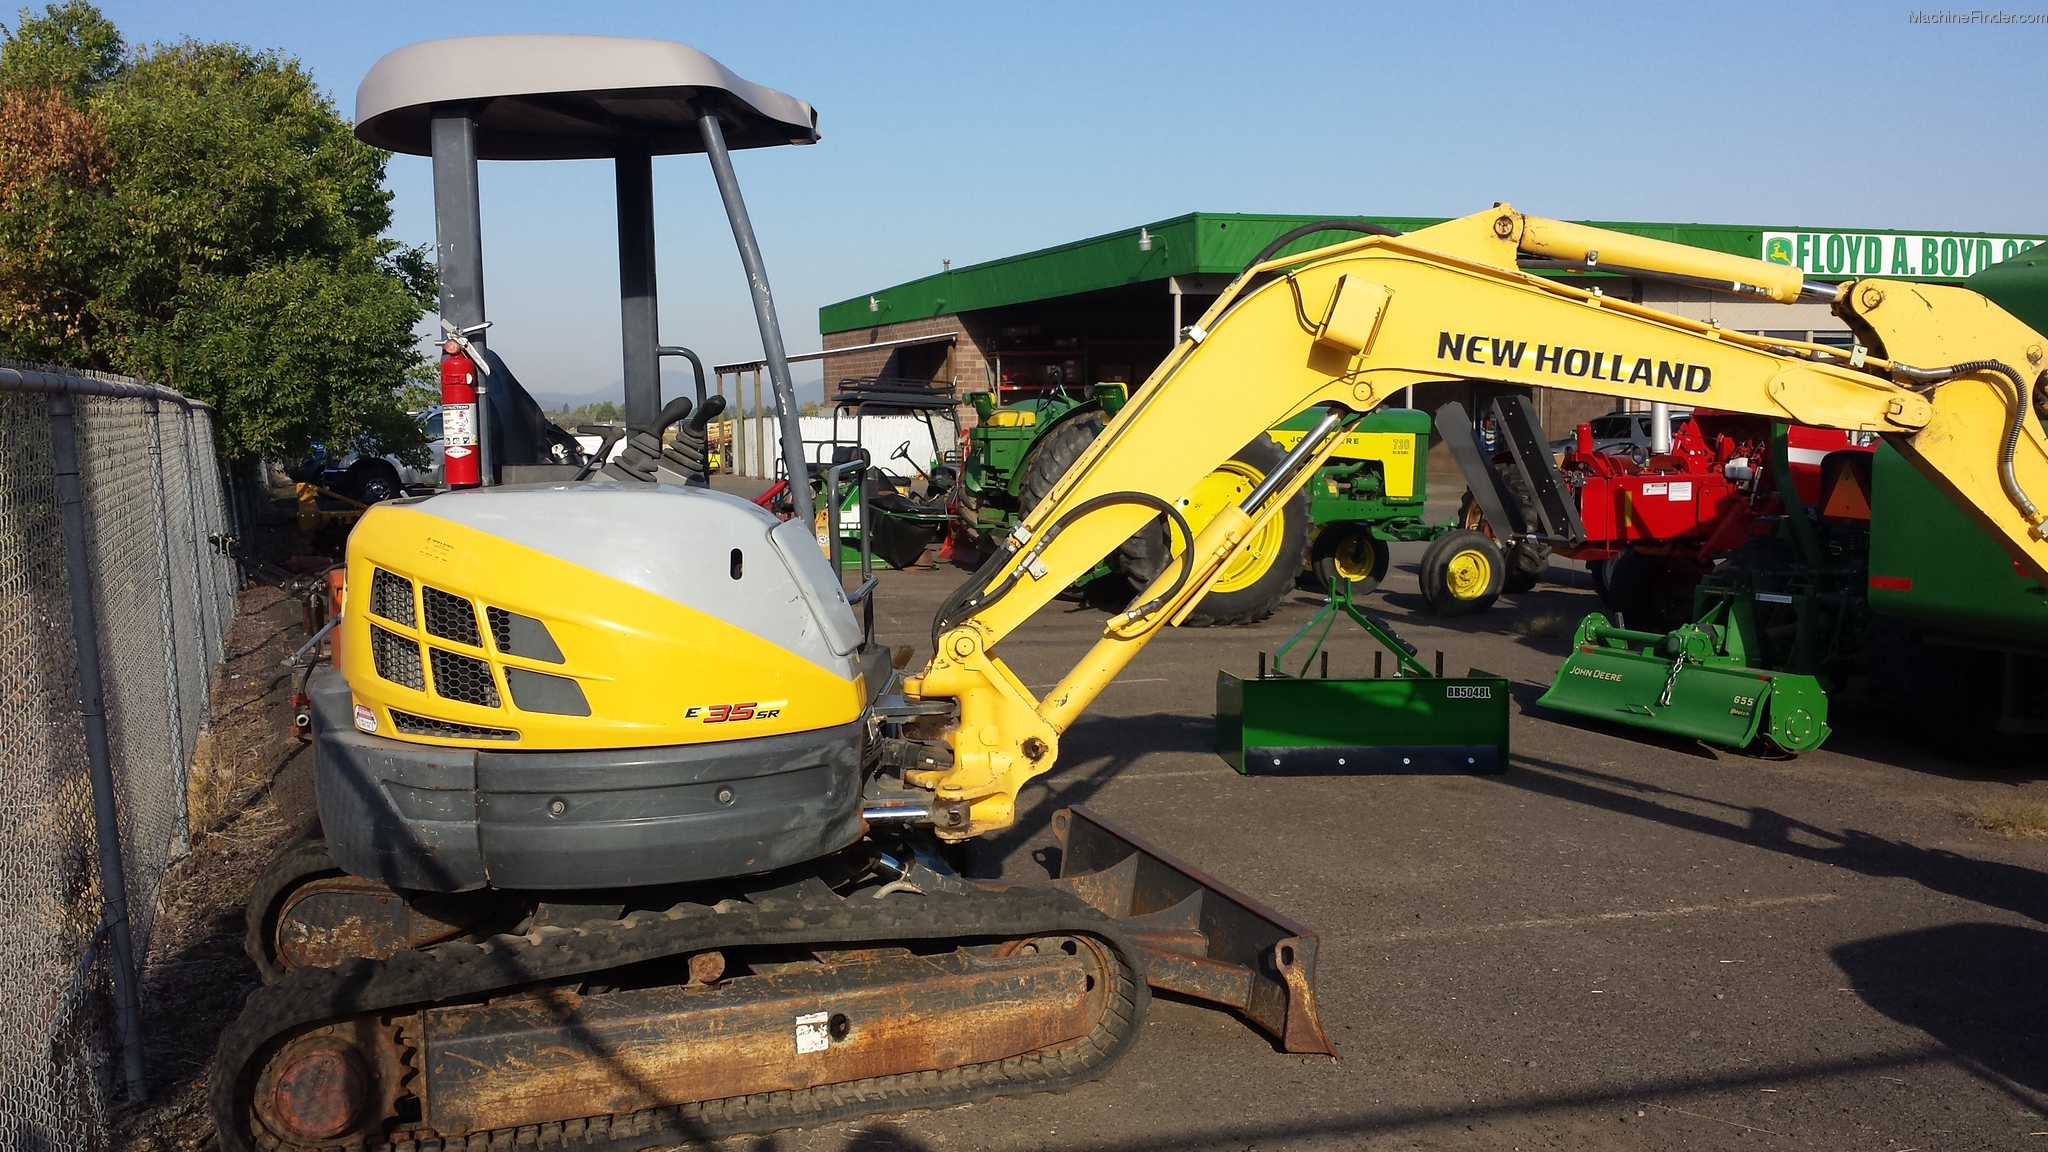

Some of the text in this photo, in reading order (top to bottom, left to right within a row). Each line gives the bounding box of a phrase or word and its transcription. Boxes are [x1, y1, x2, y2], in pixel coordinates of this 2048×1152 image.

[1796, 233, 1882, 275] FLOYD
[1891, 237, 1916, 275] A.
[1921, 237, 1993, 277] BOYD
[1437, 330, 1713, 394] NEW HOLLAND
[1392, 438, 1410, 450] 730
[1569, 665, 1623, 682] JOHN DEERE
[1447, 686, 1491, 699] BB5048L
[1733, 695, 1754, 706] 655
[684, 702, 781, 723] E 35 SR
